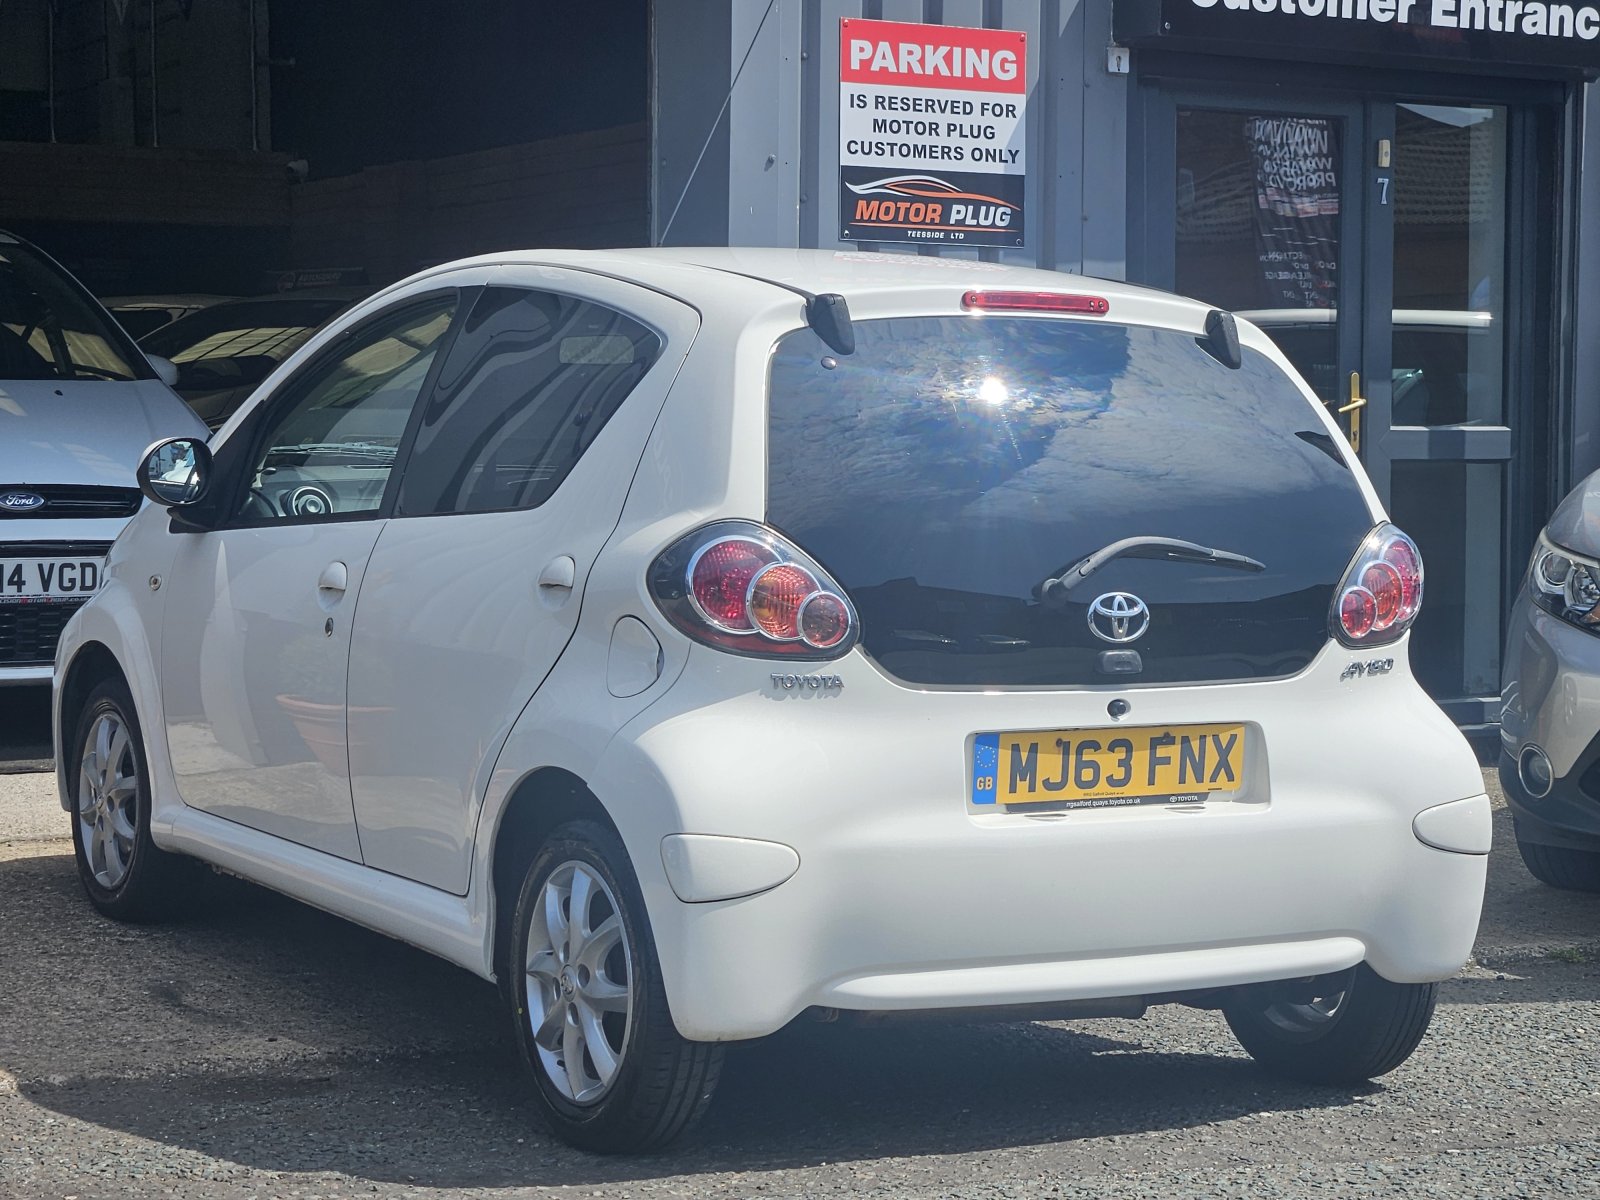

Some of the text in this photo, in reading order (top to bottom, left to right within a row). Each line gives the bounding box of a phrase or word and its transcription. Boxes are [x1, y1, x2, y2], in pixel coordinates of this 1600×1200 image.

[1191, 0, 1417, 24] omer
[850, 39, 1018, 81] PARKING
[849, 93, 1017, 119] IS RESERVED FOR
[872, 118, 996, 140] MOTOR PLUG
[846, 140, 1020, 164] CUSTOMERS ONLY
[1377, 177, 1389, 205] 7
[855, 200, 1012, 227] MOTOR PLUG
[907, 230, 965, 240] TEESSIDE LTD
[5, 494, 34, 506] Ford
[37, 562, 98, 592] VGD
[770, 673, 845, 690] TOYOTA
[1008, 733, 1238, 794] MJ63 FNX
[976, 776, 993, 791] GB
